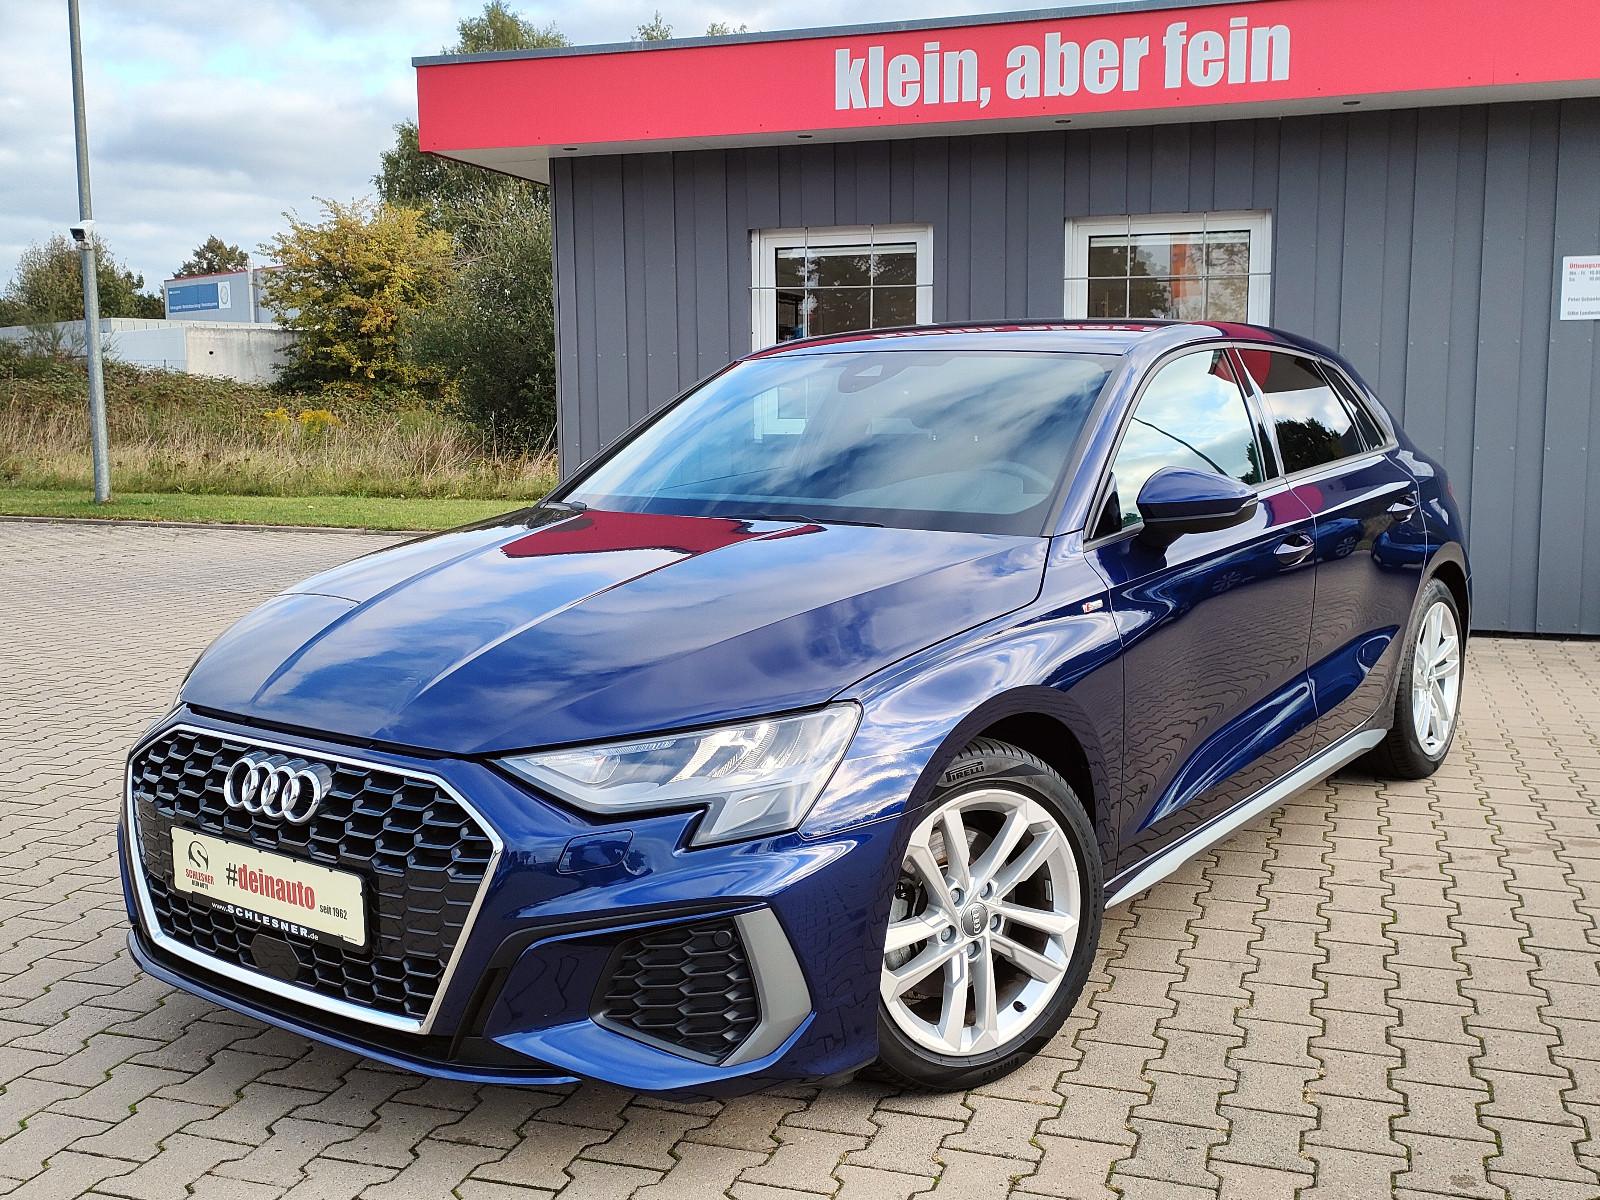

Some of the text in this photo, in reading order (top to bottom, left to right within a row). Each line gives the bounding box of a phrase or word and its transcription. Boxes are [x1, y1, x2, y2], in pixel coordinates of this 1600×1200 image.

[834, 16, 1291, 110] klein, aber fein
[945, 761, 985, 782] PIRELLI
[185, 868, 215, 886] SCHLESNER
[226, 862, 316, 910] #deinauto
[211, 901, 319, 941] www.SCHLESNER.de
[319, 904, 348, 920] seit 1962
